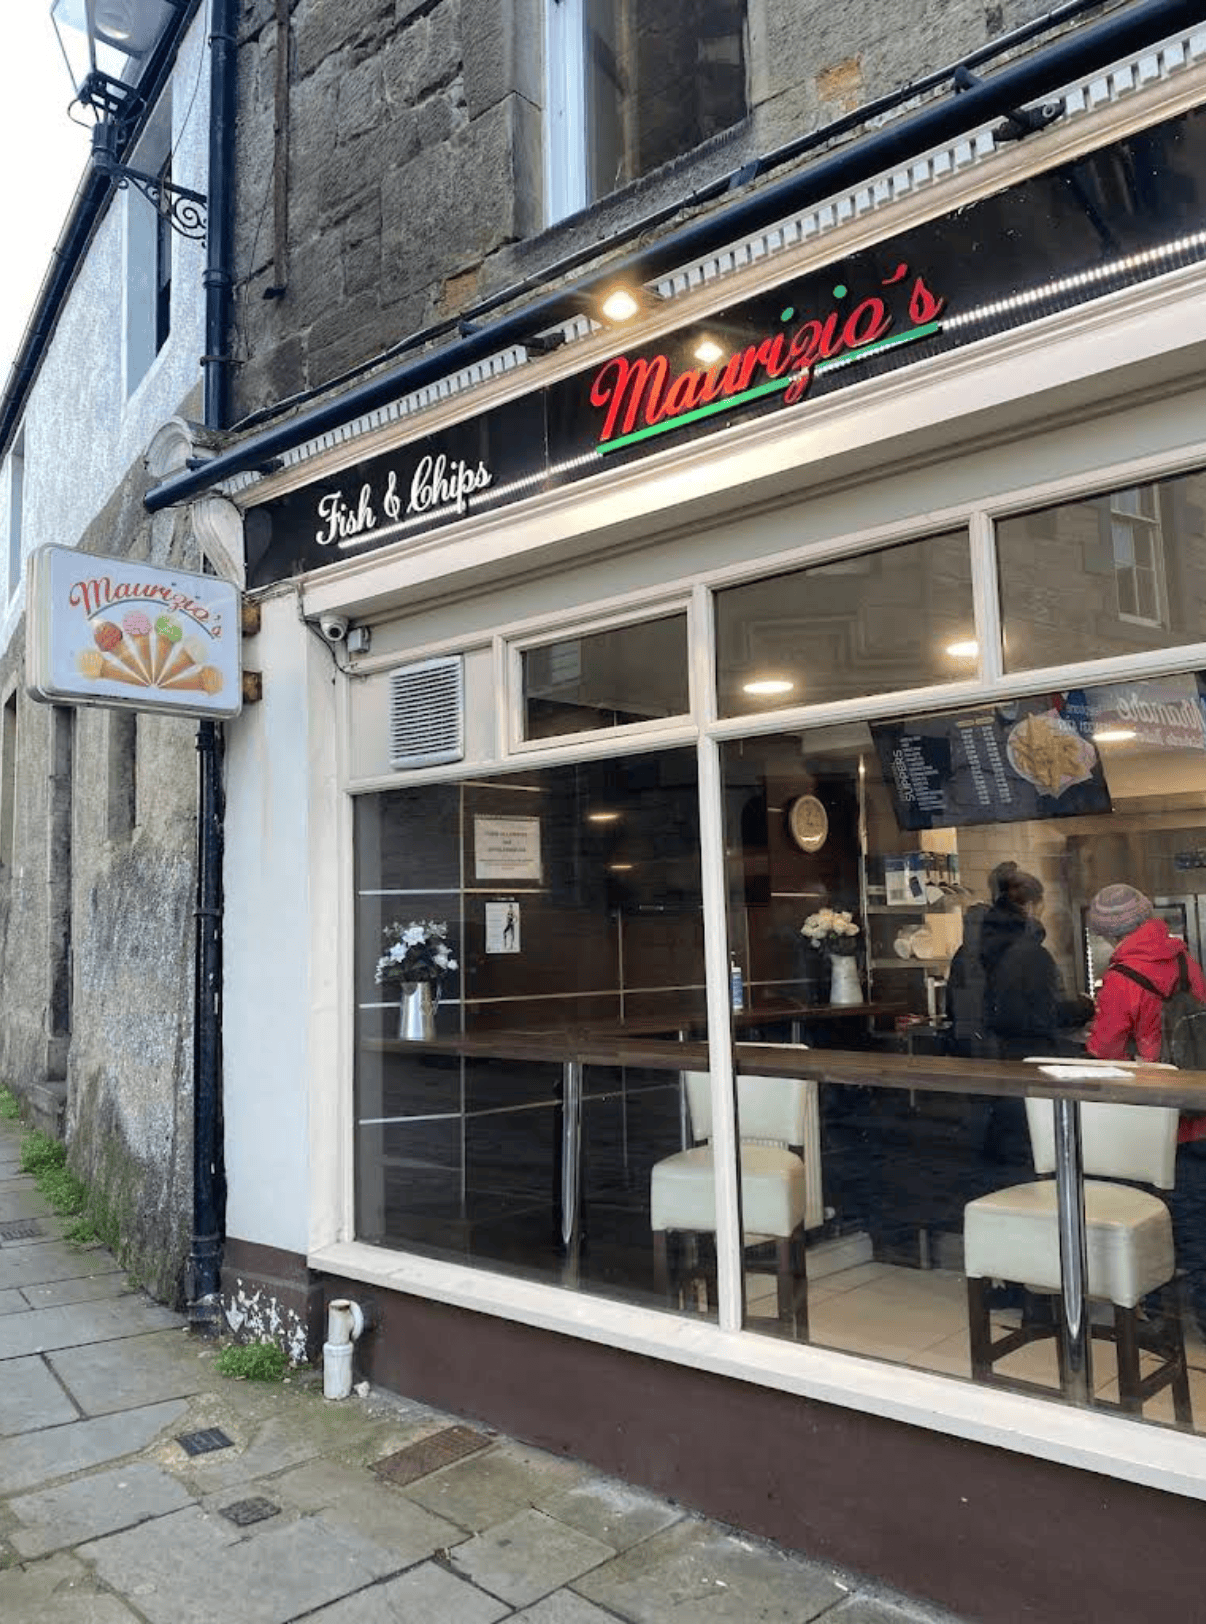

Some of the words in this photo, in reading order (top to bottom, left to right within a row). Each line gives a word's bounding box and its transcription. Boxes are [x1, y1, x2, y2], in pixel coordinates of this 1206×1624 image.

[590, 262, 944, 441] Maurizio's
[315, 483, 377, 545] Fish
[383, 470, 401, 522] &
[406, 454, 493, 514] Chips
[69, 577, 222, 638] Maurizio's
[893, 749, 916, 802] SUPPERS
